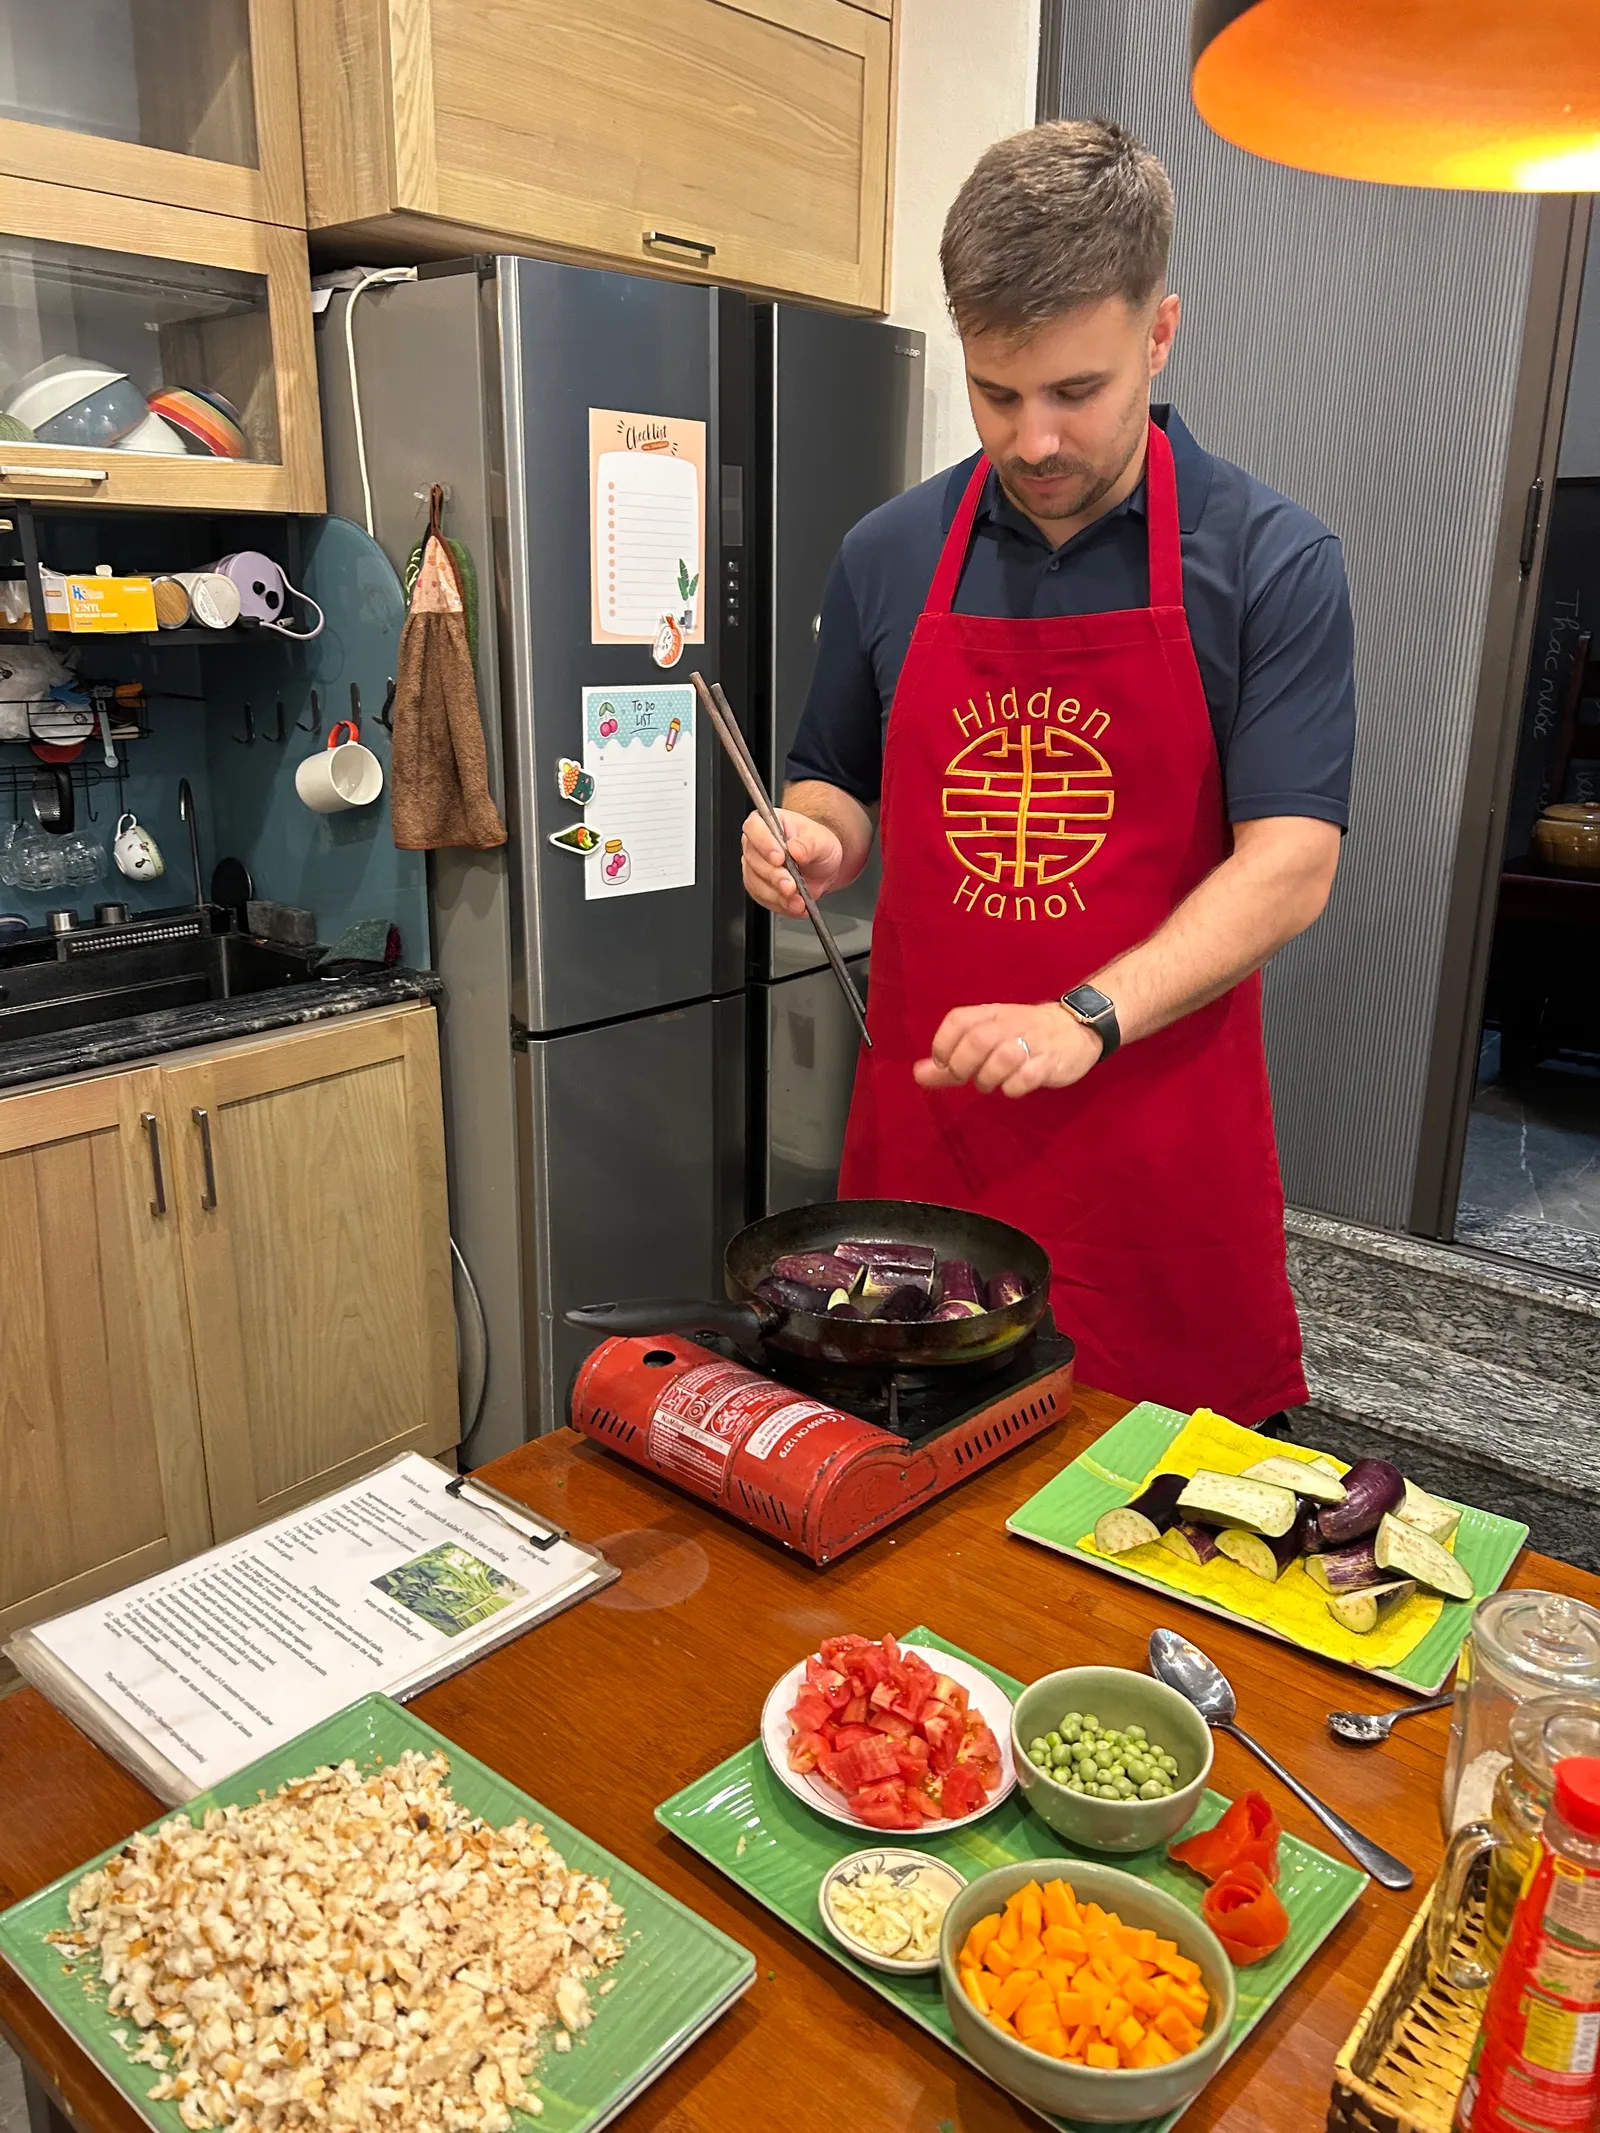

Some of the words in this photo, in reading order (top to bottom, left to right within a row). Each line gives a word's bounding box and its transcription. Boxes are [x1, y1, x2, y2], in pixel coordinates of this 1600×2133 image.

[626, 424, 668, 450] Checklist
[73, 603, 100, 612] VINYL
[636, 713, 653, 726] LIST
[953, 687, 1111, 739] Hidden
[953, 875, 1086, 920] Hanoi
[795, 1427, 809, 1439] CN
[778, 1437, 799, 1459] 1279
[408, 1498, 426, 1511] Water
[424, 1509, 447, 1524] spinach
[475, 1540, 488, 1549] rau
